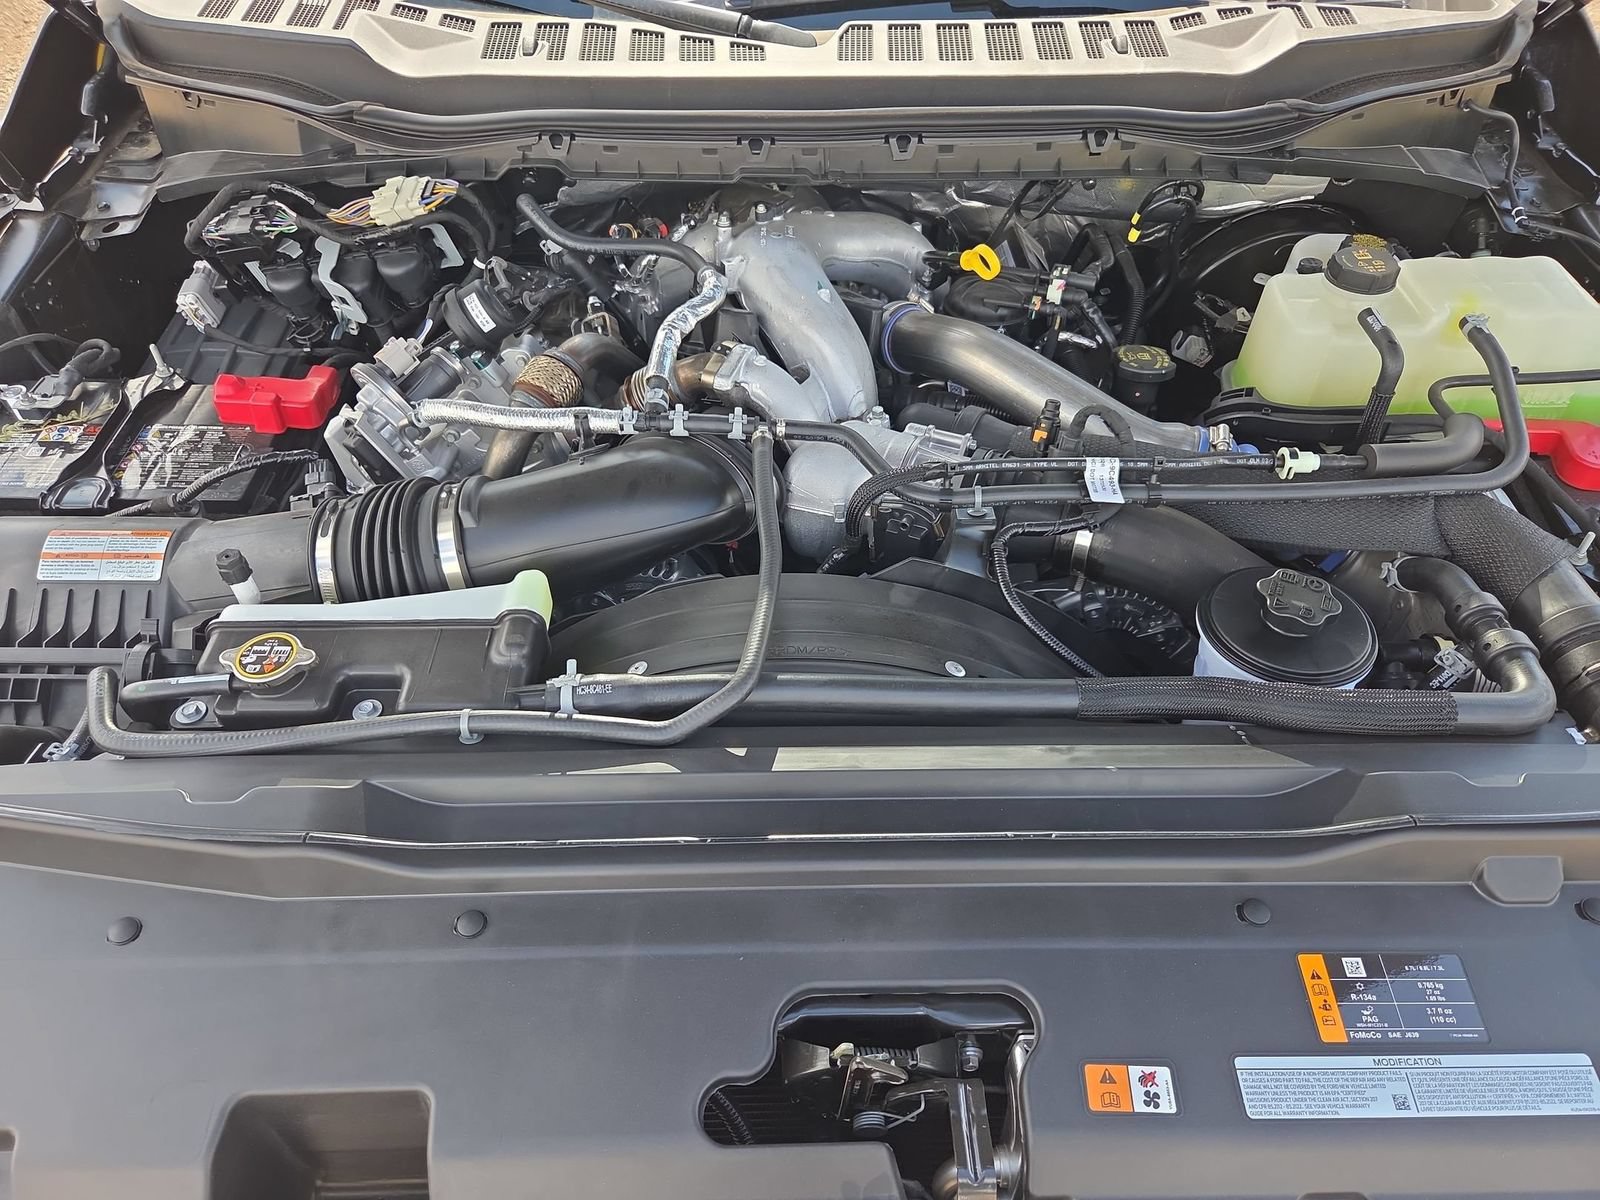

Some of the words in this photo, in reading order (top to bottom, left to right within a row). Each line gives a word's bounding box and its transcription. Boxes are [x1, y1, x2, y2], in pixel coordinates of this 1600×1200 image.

[1435, 982, 1444, 991] kg
[1426, 1008, 1436, 1016] 3.7
[1350, 1031, 1382, 1040] FoMoCo
[1373, 1058, 1442, 1066] MODIFICATION
